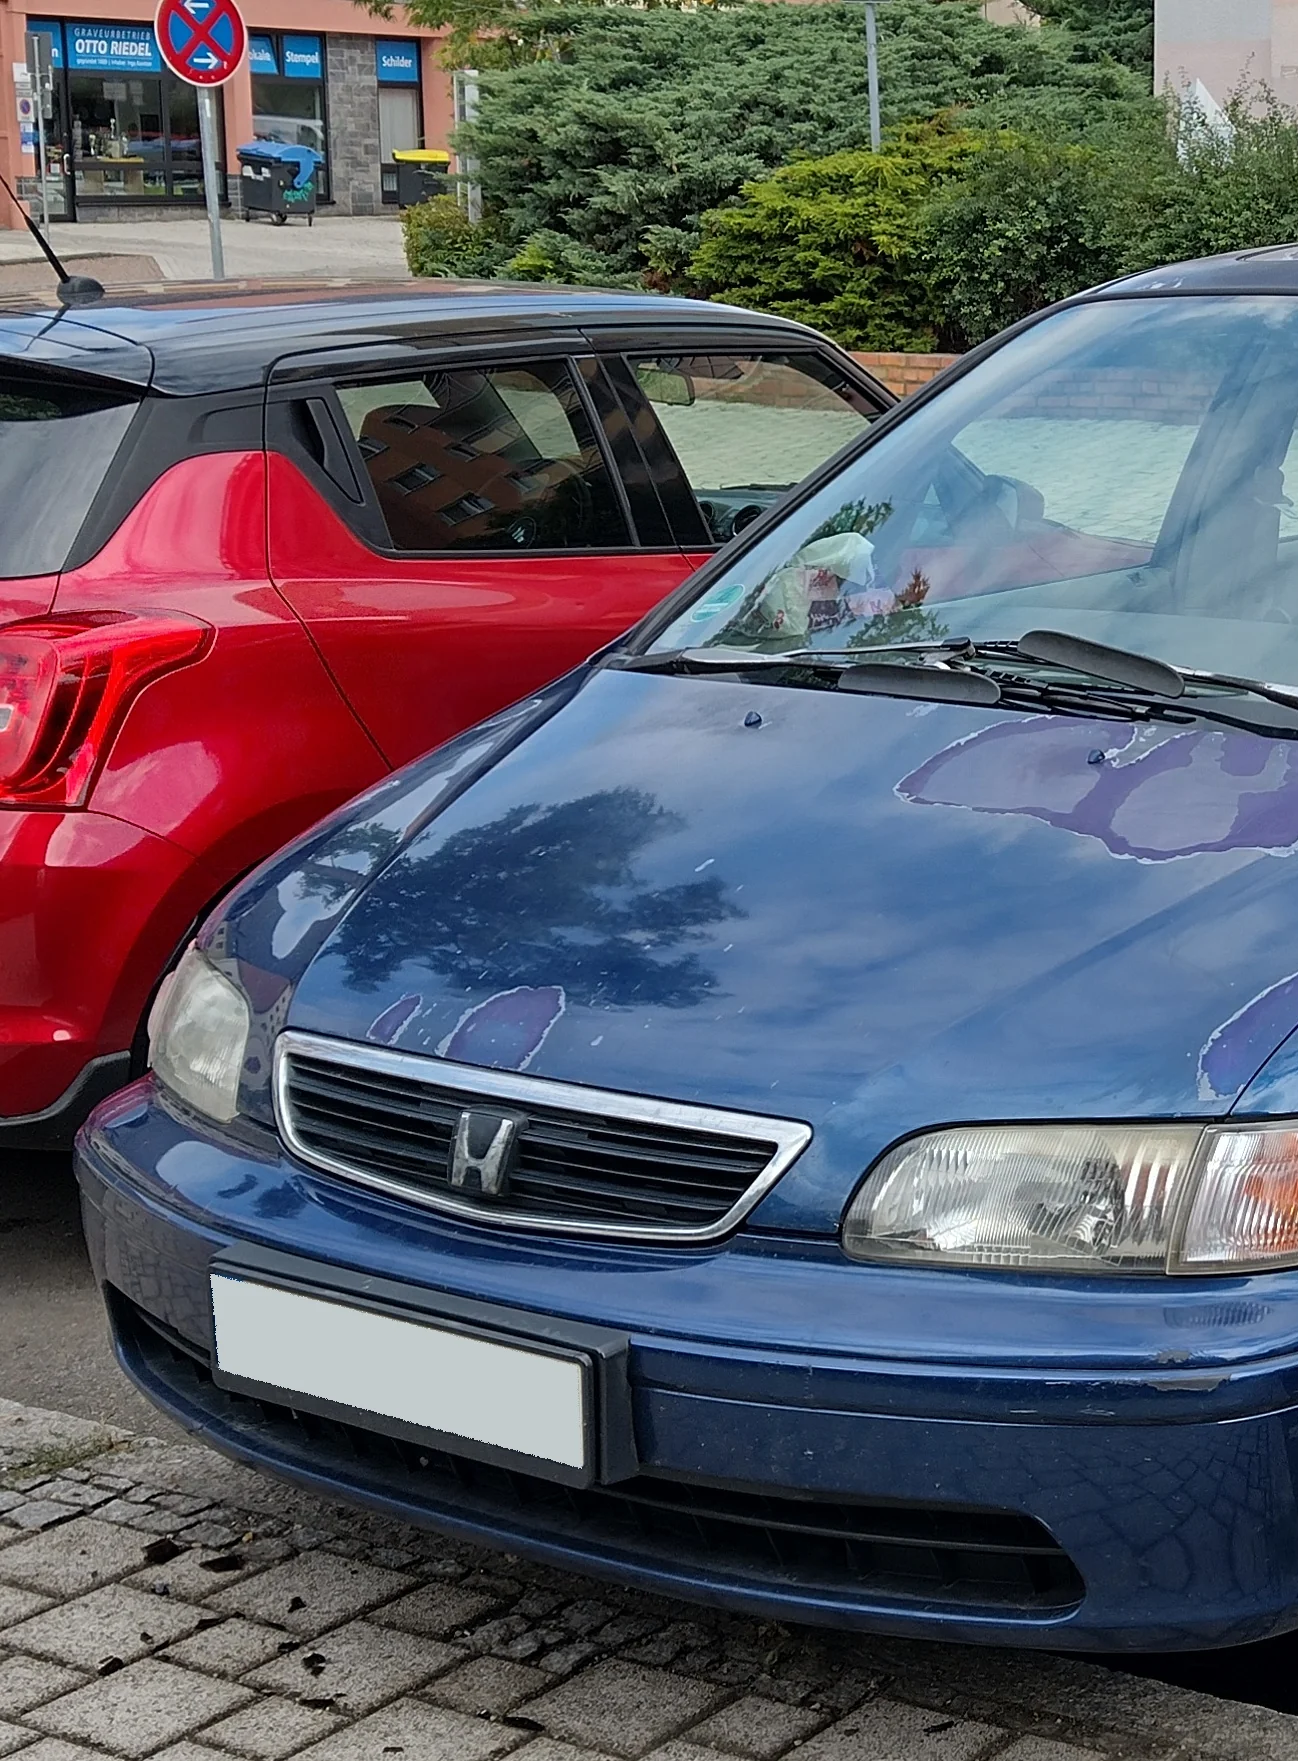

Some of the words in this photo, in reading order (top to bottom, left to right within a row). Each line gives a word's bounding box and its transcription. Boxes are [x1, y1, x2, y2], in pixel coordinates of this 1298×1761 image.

[74, 27, 151, 40] GRAVEURBETRIEB
[75, 39, 108, 54] OTTO
[110, 41, 152, 56] RIEDEL
[248, 49, 271, 62] okale
[285, 51, 320, 67] Stempel
[382, 55, 413, 68] Schilder
